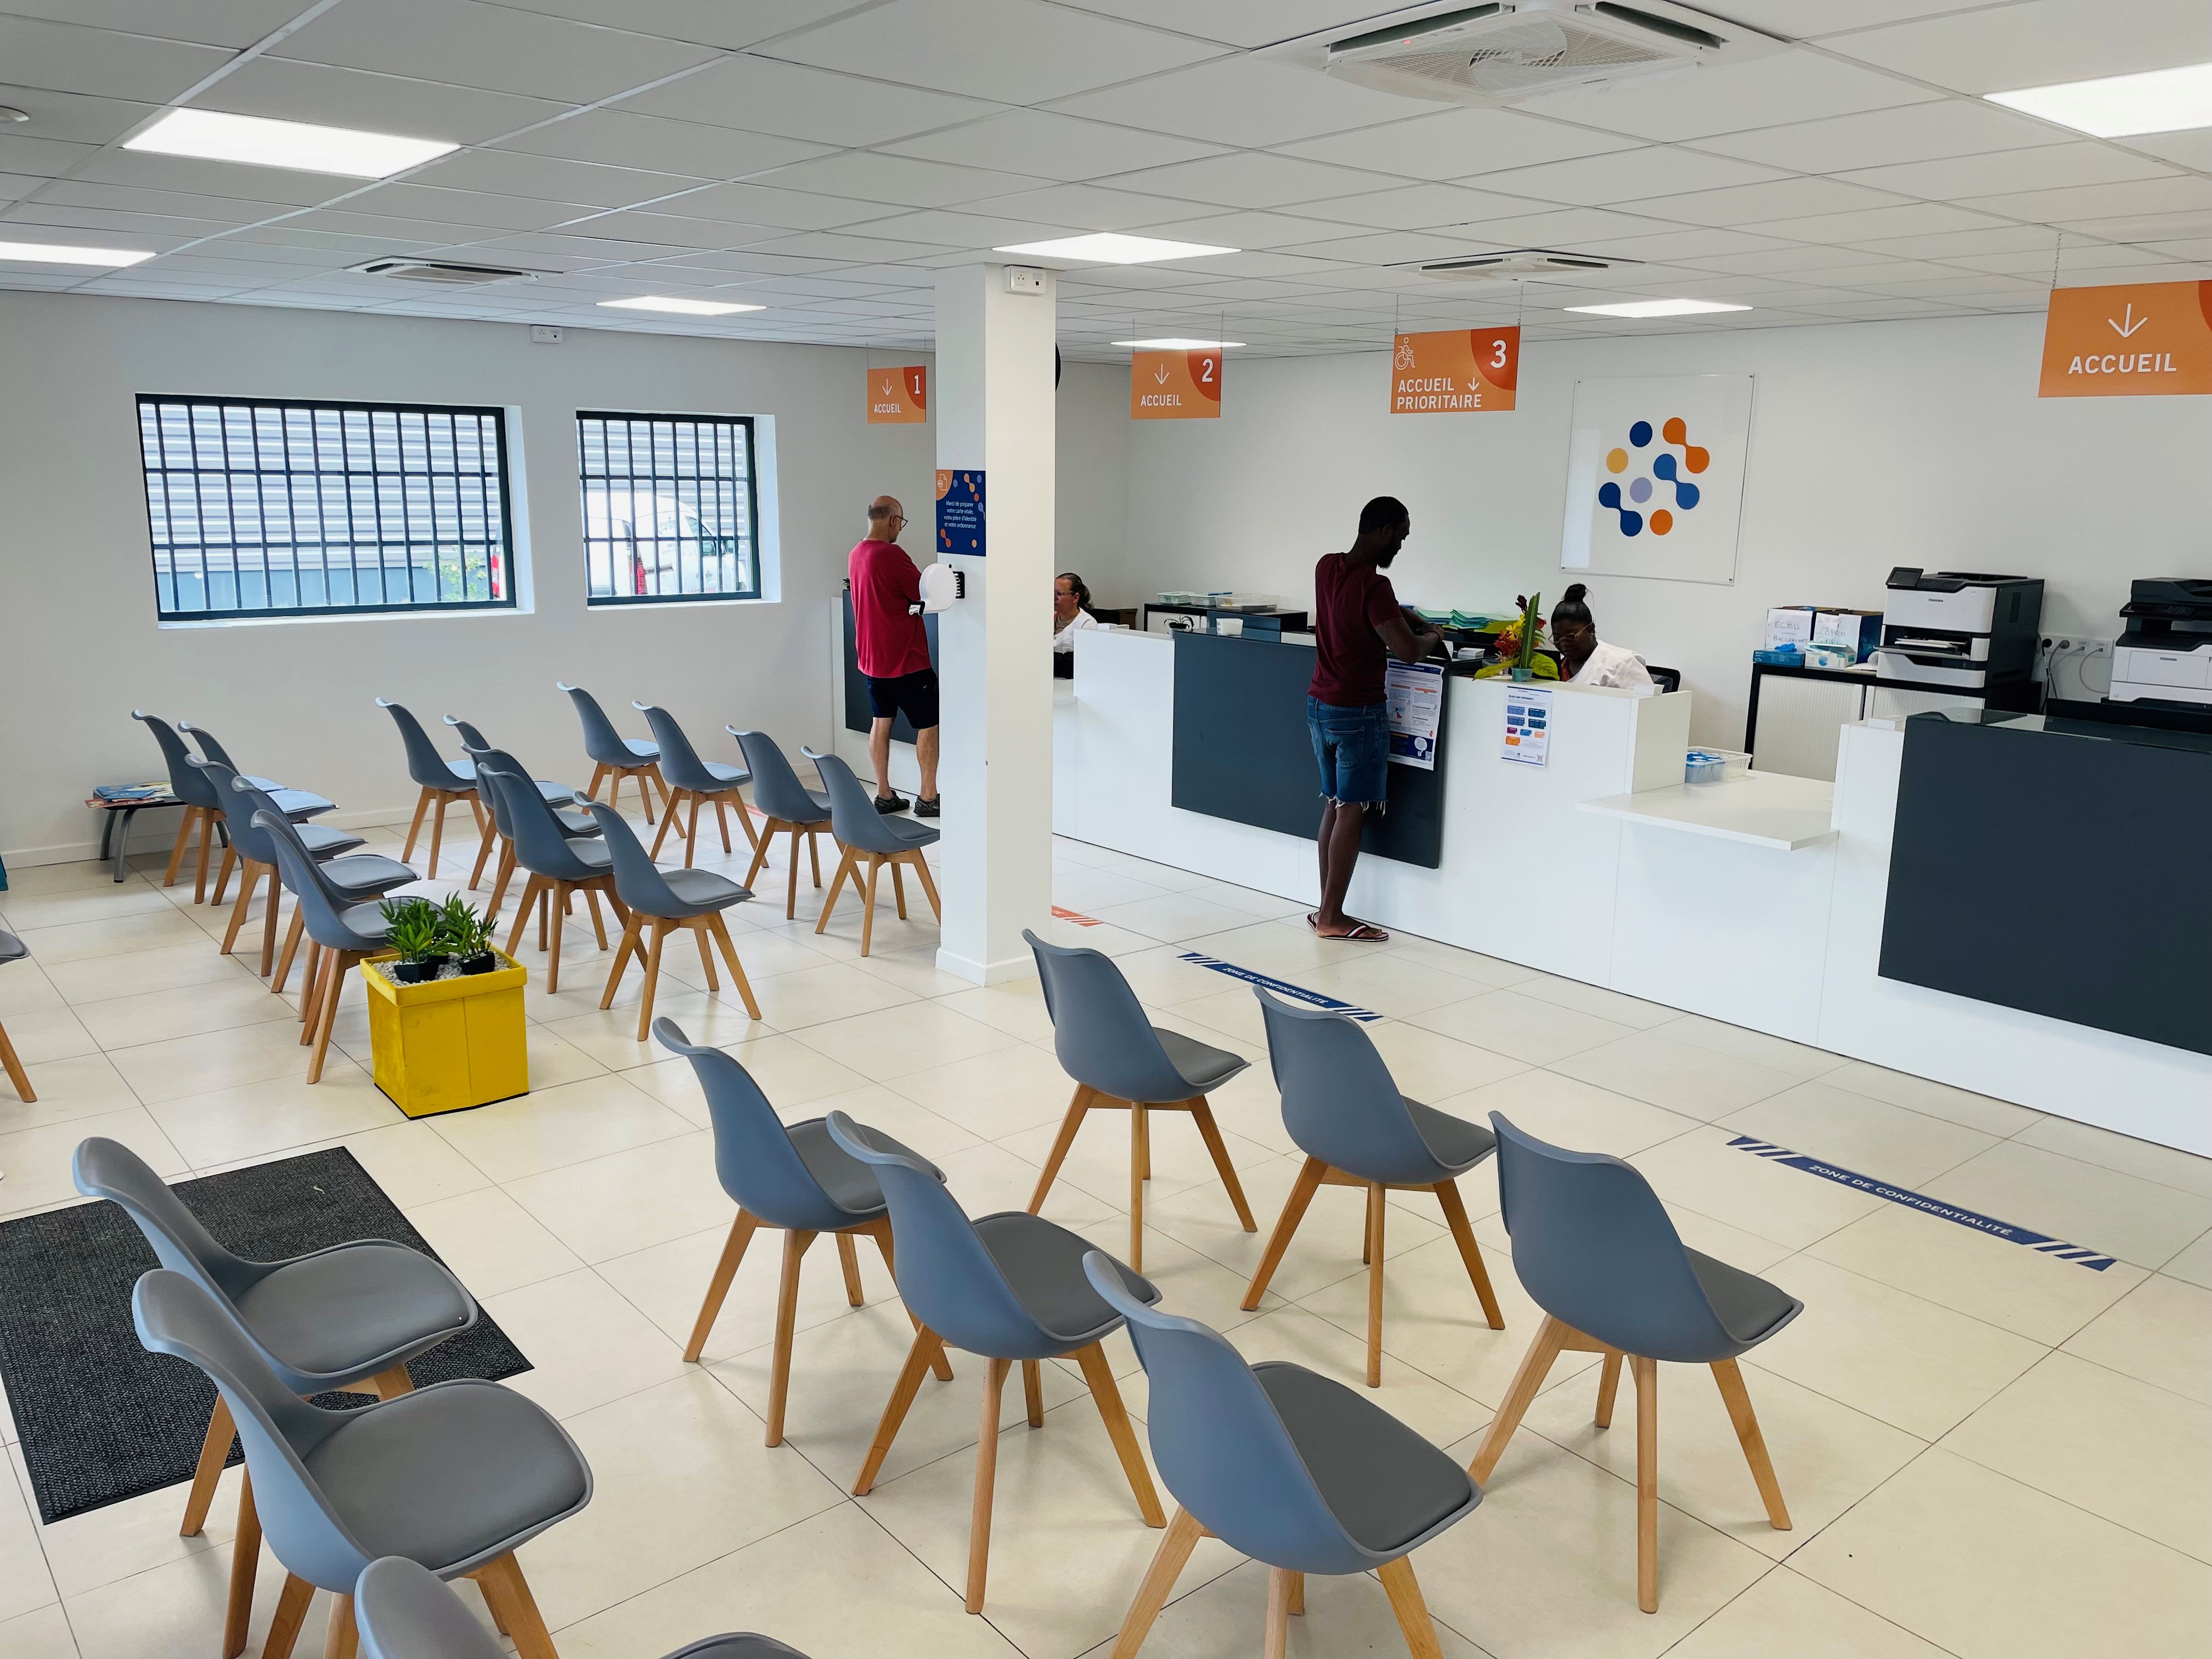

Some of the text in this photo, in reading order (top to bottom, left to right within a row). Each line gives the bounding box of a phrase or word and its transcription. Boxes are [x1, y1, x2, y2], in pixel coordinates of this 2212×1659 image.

[1490, 340, 1507, 369] 3
[2067, 352, 2177, 375] ACCUEIL
[1201, 358, 1214, 382] 2
[914, 375, 921, 394] 1
[1398, 377, 1454, 393] ACCUEIL
[874, 403, 901, 414] ACCUEIL
[1141, 394, 1182, 407] ACCUEIL
[1397, 394, 1482, 410] PRIORITAIRE
[1222, 967, 1246, 977] ZONE
[1256, 979, 1329, 1005] CONFIDENTIALITÉ
[1809, 1165, 2013, 1236] ZONE DE CONFIDENTIALITÉ
